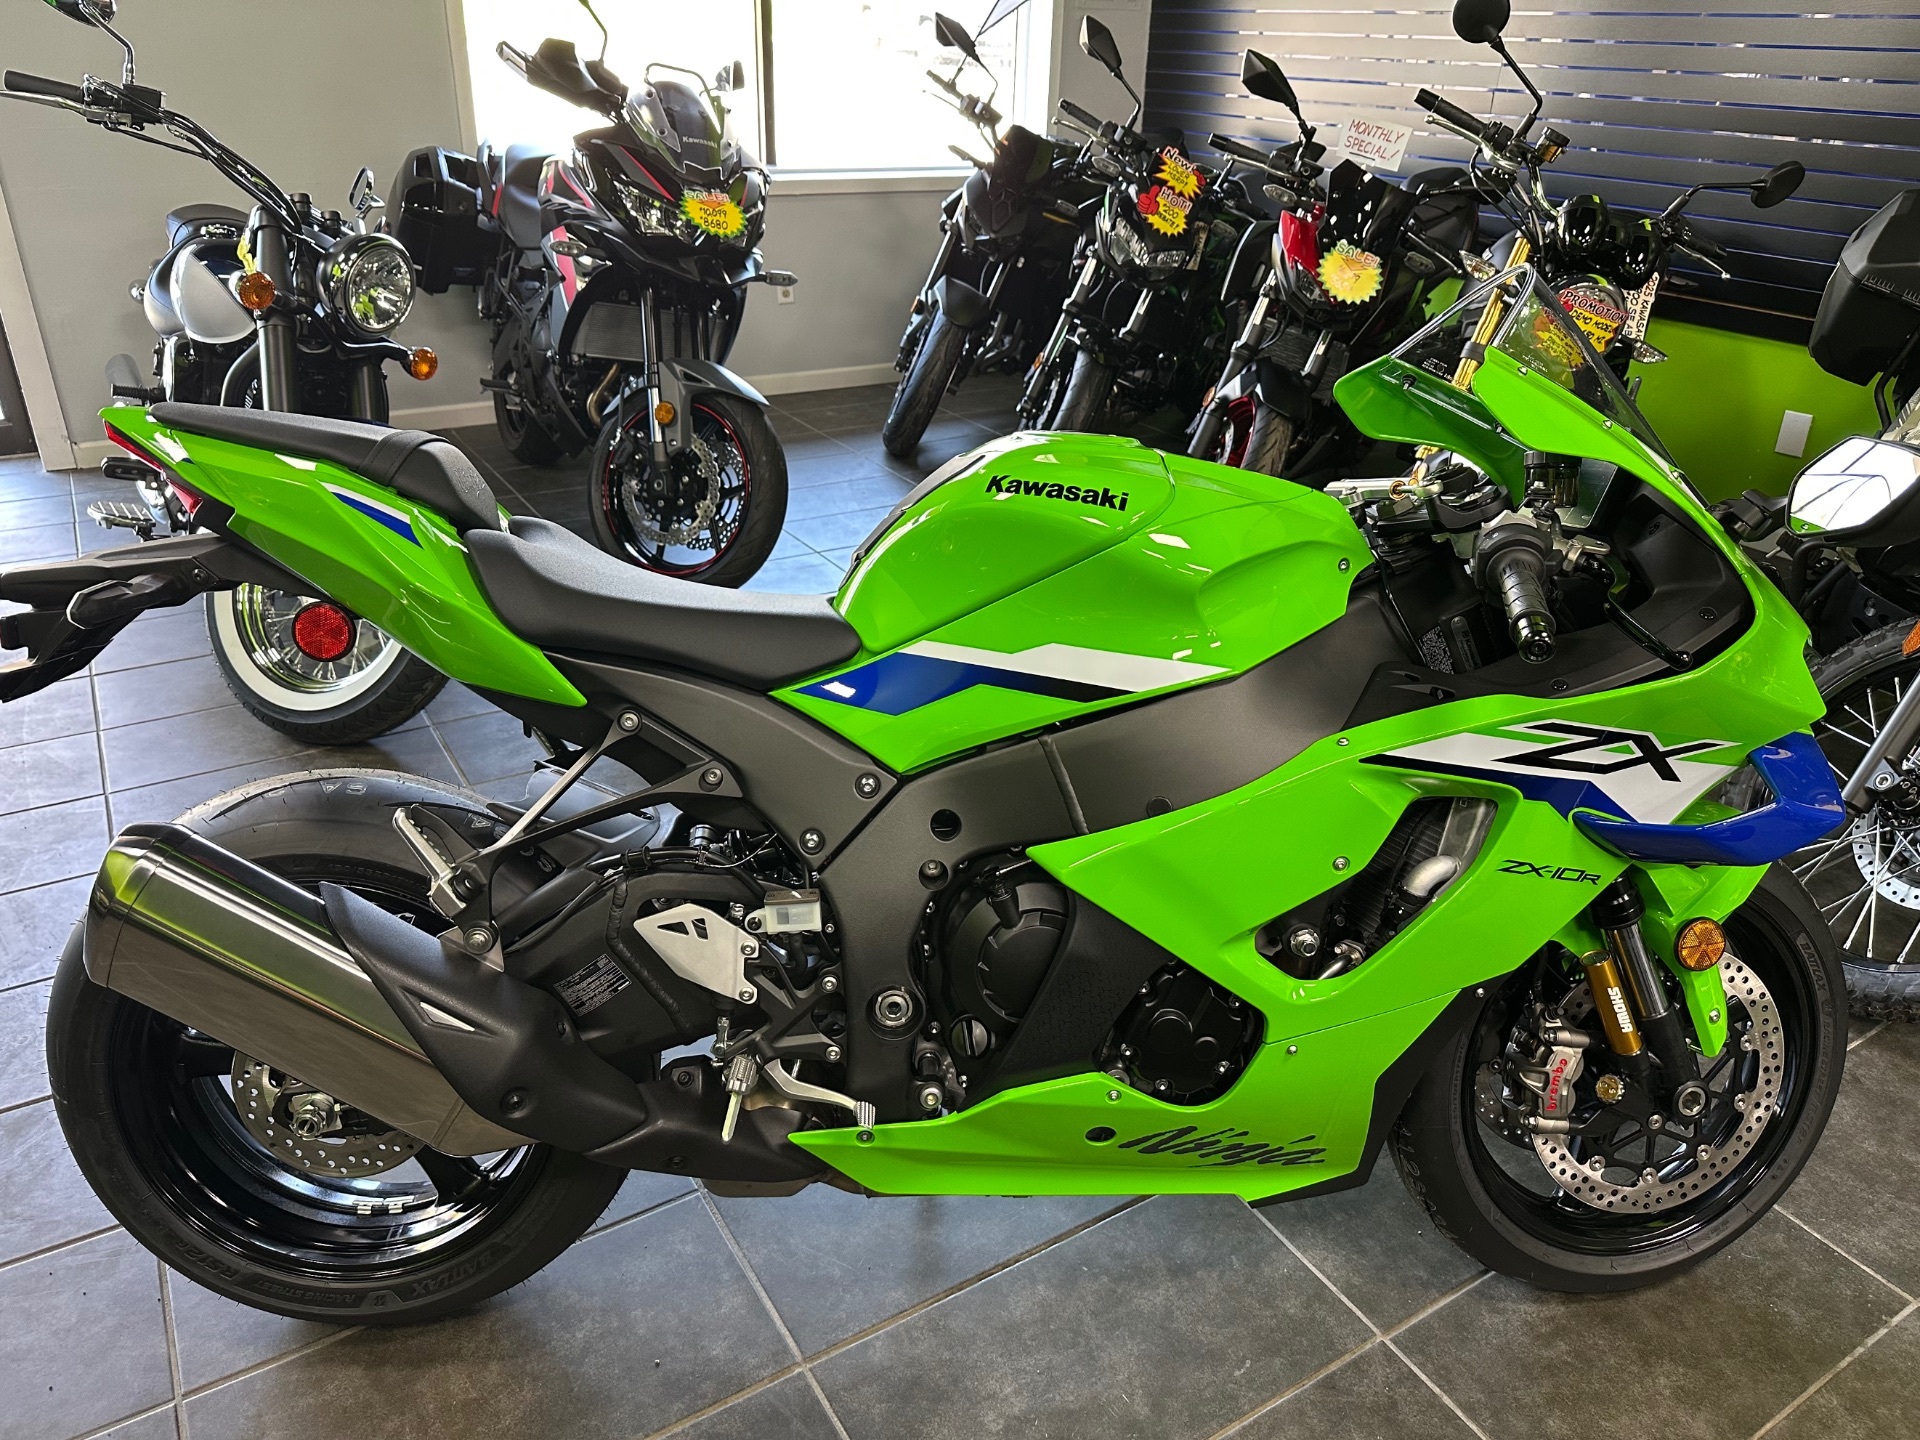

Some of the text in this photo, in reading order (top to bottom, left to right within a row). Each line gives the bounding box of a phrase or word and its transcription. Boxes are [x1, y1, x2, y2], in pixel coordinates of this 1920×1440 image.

[682, 136, 718, 149] Kawasaki
[1348, 119, 1405, 144] MONTHLY
[1163, 146, 1197, 173] New!
[1344, 135, 1400, 161] SPECIAL!
[1167, 171, 1188, 188] MSRP!
[1168, 163, 1190, 180] LOWER
[683, 190, 730, 203] SALE!
[1160, 187, 1193, 213] HOT!
[699, 206, 728, 219] $10,099
[700, 216, 729, 230] $8680
[1162, 203, 1179, 219] $200
[1336, 241, 1381, 268] SALE!
[1563, 291, 1626, 322] PROMOTION
[1571, 309, 1593, 325] DEMO
[1635, 276, 1658, 340] 2025 KAWASAK
[1592, 320, 1613, 334] MODEL
[1625, 323, 1633, 337] AB
[985, 474, 1130, 512] Kawasaki
[1489, 721, 1726, 783] ZX
[1495, 859, 1602, 886] ZX-10R
[1801, 940, 1826, 993] BATTLAX
[1607, 986, 1634, 1034] SHOWA
[1546, 1058, 1568, 1111] brembo
[1117, 1125, 1328, 1168] Ninja
[254, 1280, 356, 1304] RACING STREET
